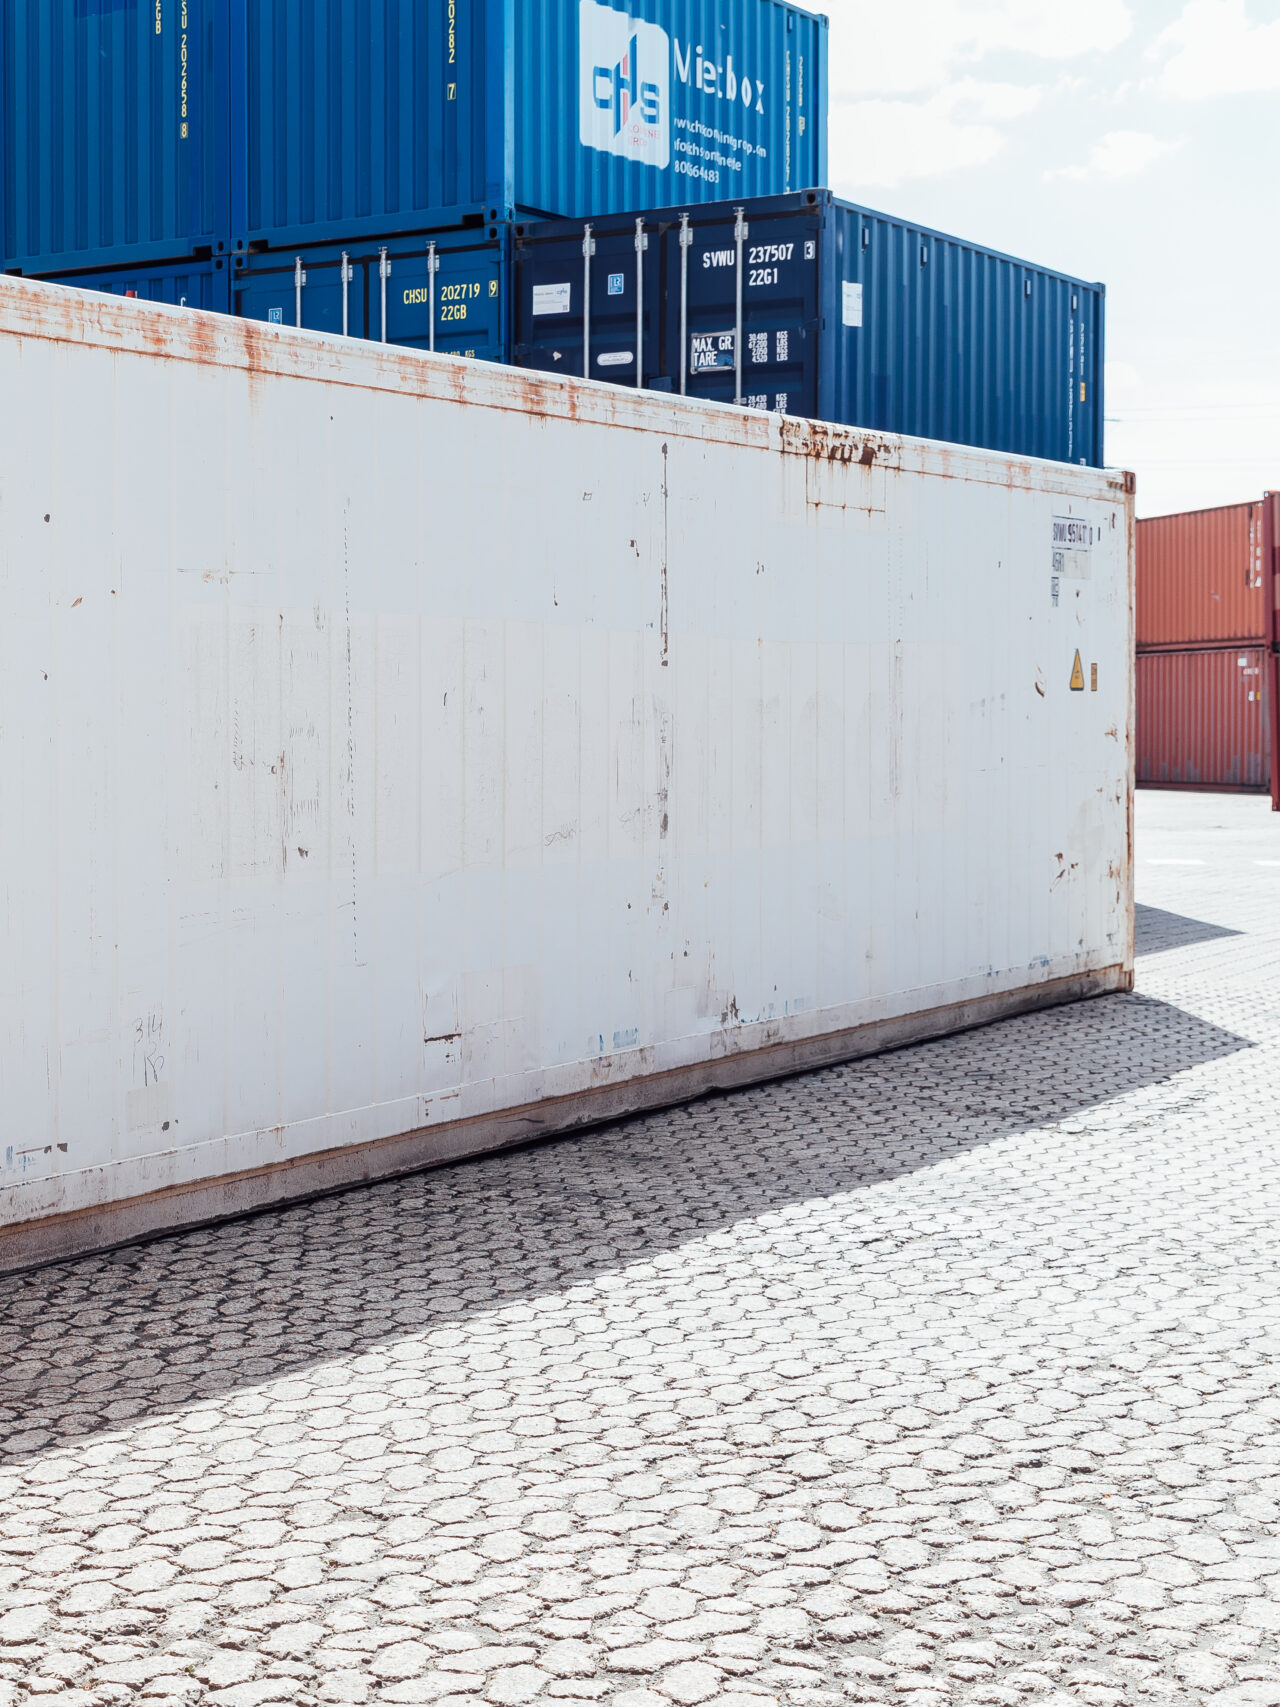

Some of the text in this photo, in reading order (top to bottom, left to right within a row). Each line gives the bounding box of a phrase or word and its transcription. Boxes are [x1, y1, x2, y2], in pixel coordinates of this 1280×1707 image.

[180, 34, 188, 118] 202658
[449, 84, 455, 99] 7
[181, 123, 188, 138] 8
[703, 242, 814, 268] SVWU 237507 3
[749, 268, 778, 286] 22G1
[403, 281, 497, 304] CHSU 202719 9
[441, 305, 466, 321] 22GB
[692, 336, 733, 352] MAX. GR.
[693, 351, 718, 366] TARE
